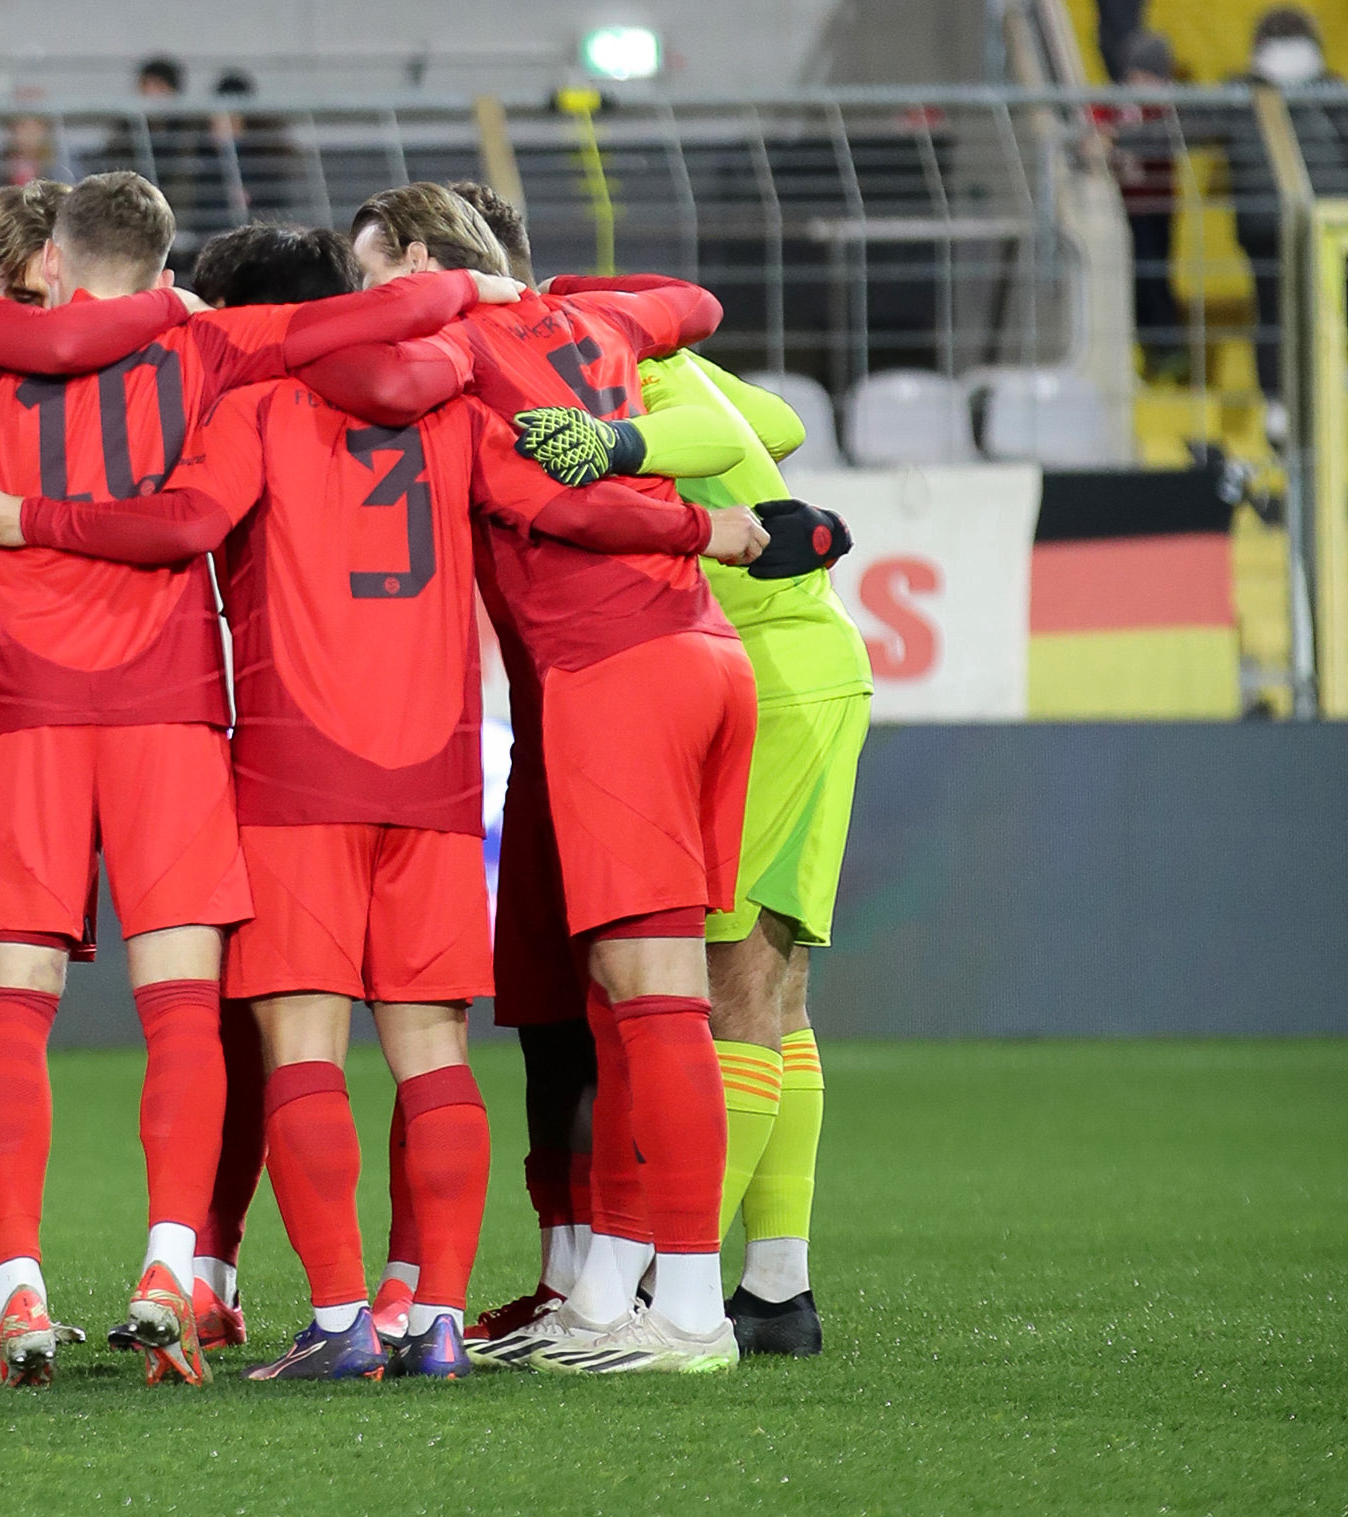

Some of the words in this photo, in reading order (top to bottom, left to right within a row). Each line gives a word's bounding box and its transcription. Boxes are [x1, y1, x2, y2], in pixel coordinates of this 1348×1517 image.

[15, 341, 187, 502] 10
[345, 423, 437, 599] 3
[859, 555, 943, 683] S
